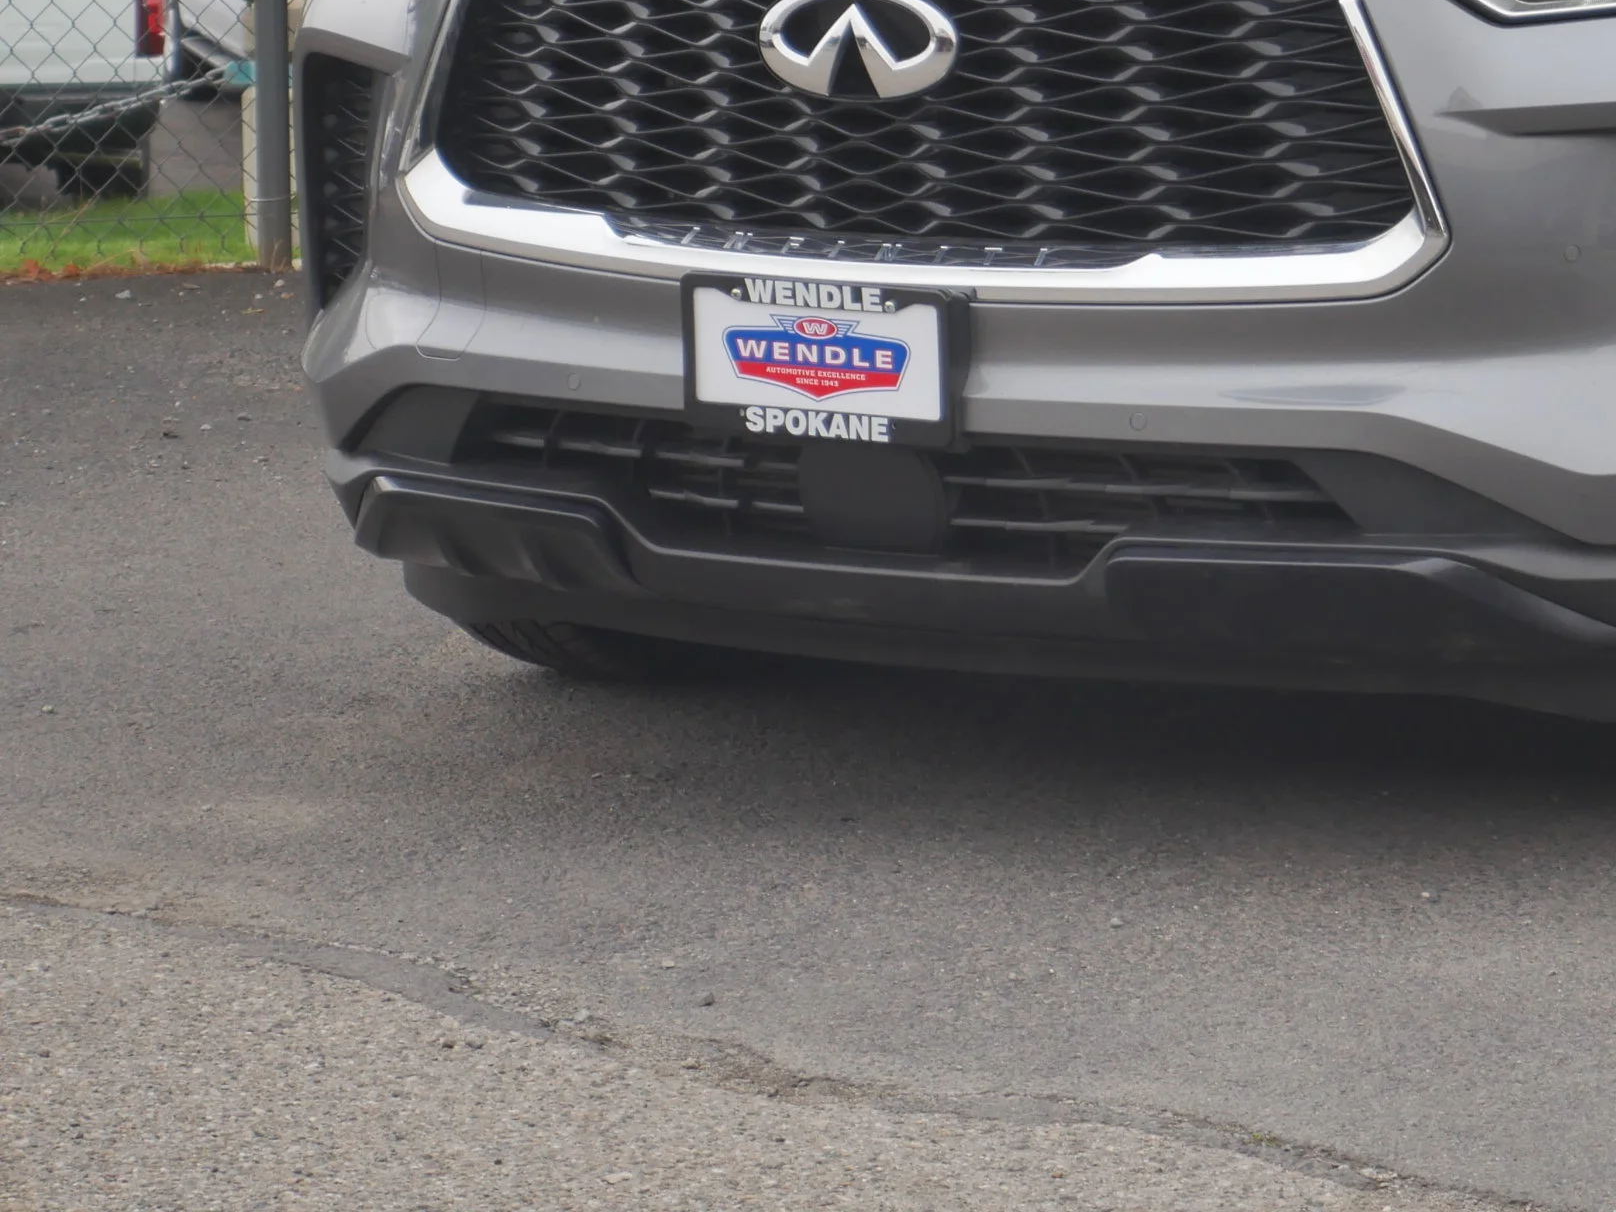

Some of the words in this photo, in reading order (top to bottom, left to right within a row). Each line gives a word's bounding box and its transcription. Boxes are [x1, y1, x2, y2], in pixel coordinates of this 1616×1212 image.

[744, 277, 884, 313] WENDLE
[736, 338, 894, 370] WENDLE
[766, 366, 816, 377] AUTOMOTIVE
[817, 370, 866, 381] EXCELLENCE
[795, 377, 820, 386] SINCE
[821, 379, 840, 387] 1943
[745, 405, 890, 443] SPOKANE
